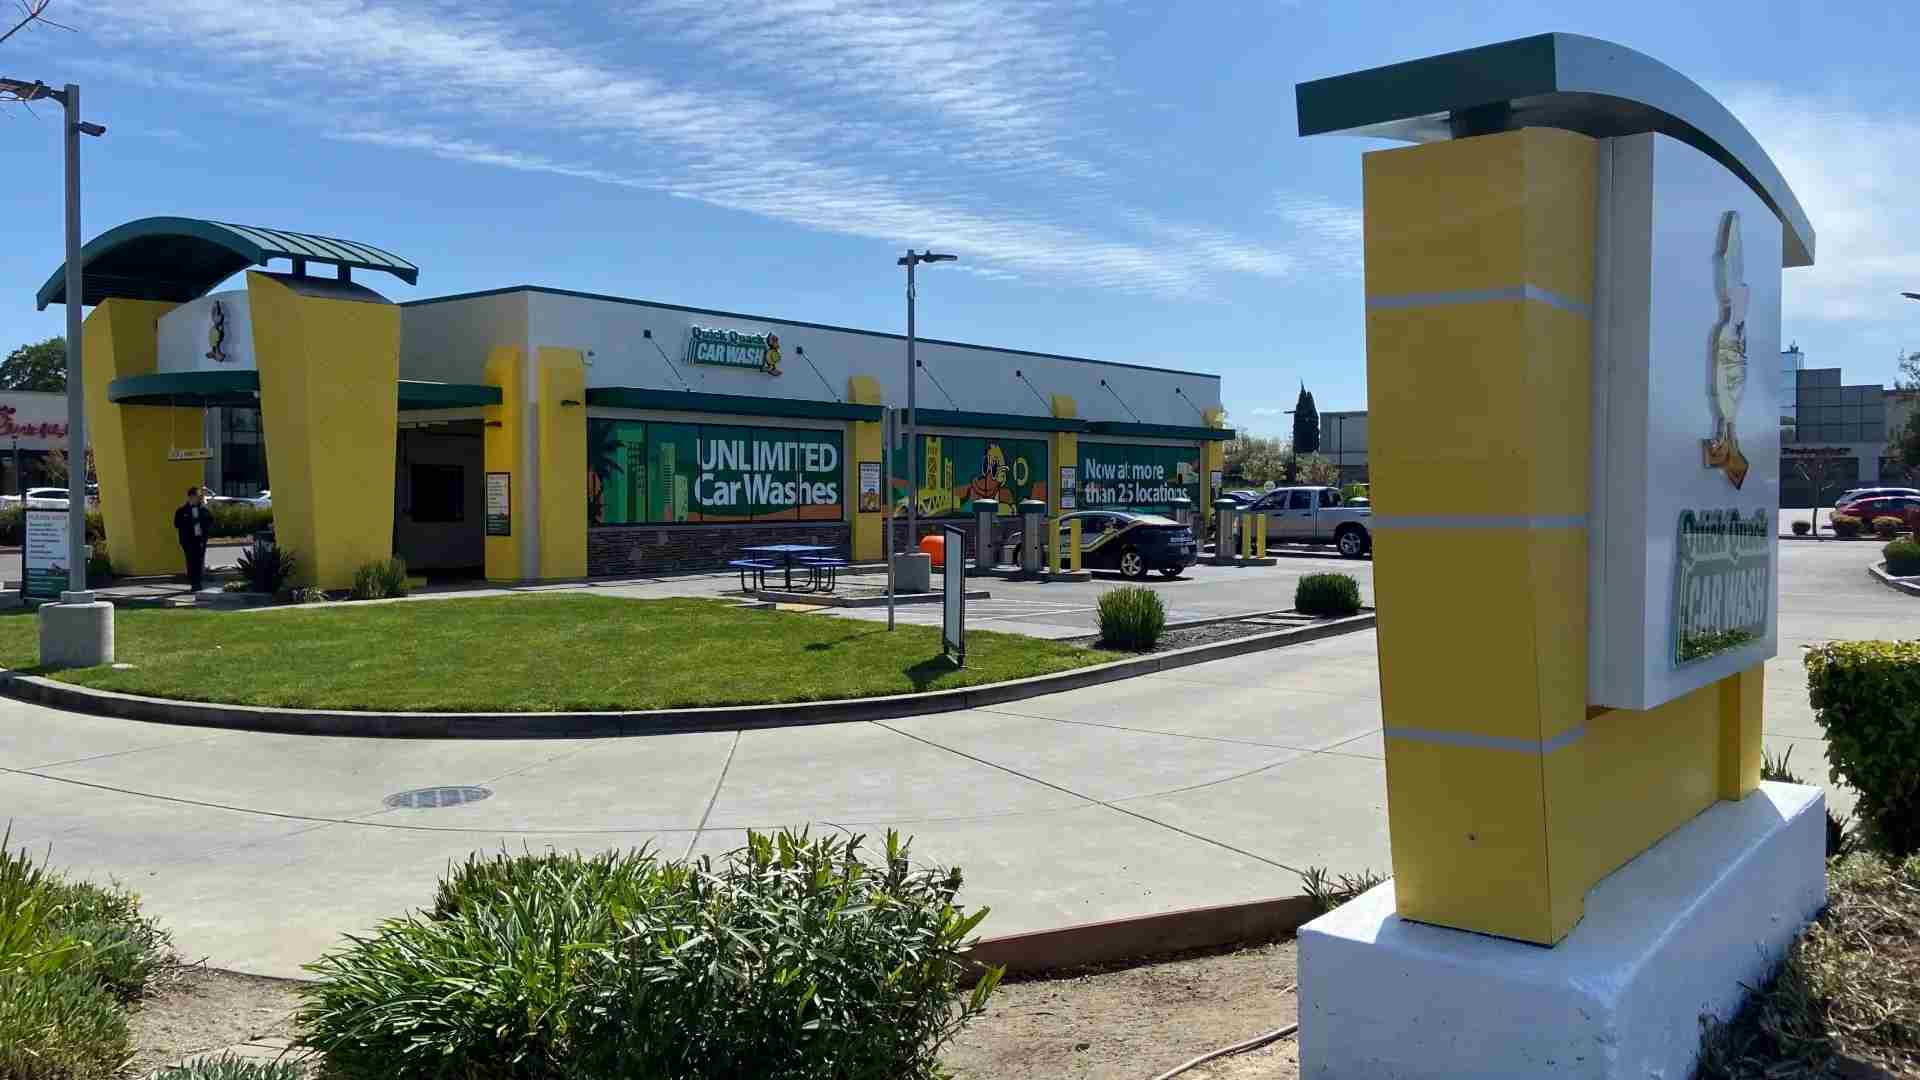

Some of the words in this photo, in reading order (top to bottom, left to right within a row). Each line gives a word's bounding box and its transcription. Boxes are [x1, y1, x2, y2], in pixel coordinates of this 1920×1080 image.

[692, 326, 727, 342] Quick
[729, 331, 765, 346] Quack
[697, 342, 725, 362] CAR
[725, 344, 765, 367] WASH
[696, 438, 838, 472] UNLIMITED
[1085, 458, 1115, 480] Now
[1117, 461, 1129, 480] at
[1132, 465, 1164, 480] more
[694, 472, 741, 506] Car
[743, 473, 838, 505] Washes
[1085, 484, 1116, 504] than
[1118, 483, 1133, 503] 25
[1687, 574, 1724, 639] CAR
[1725, 567, 1766, 631] WASH
